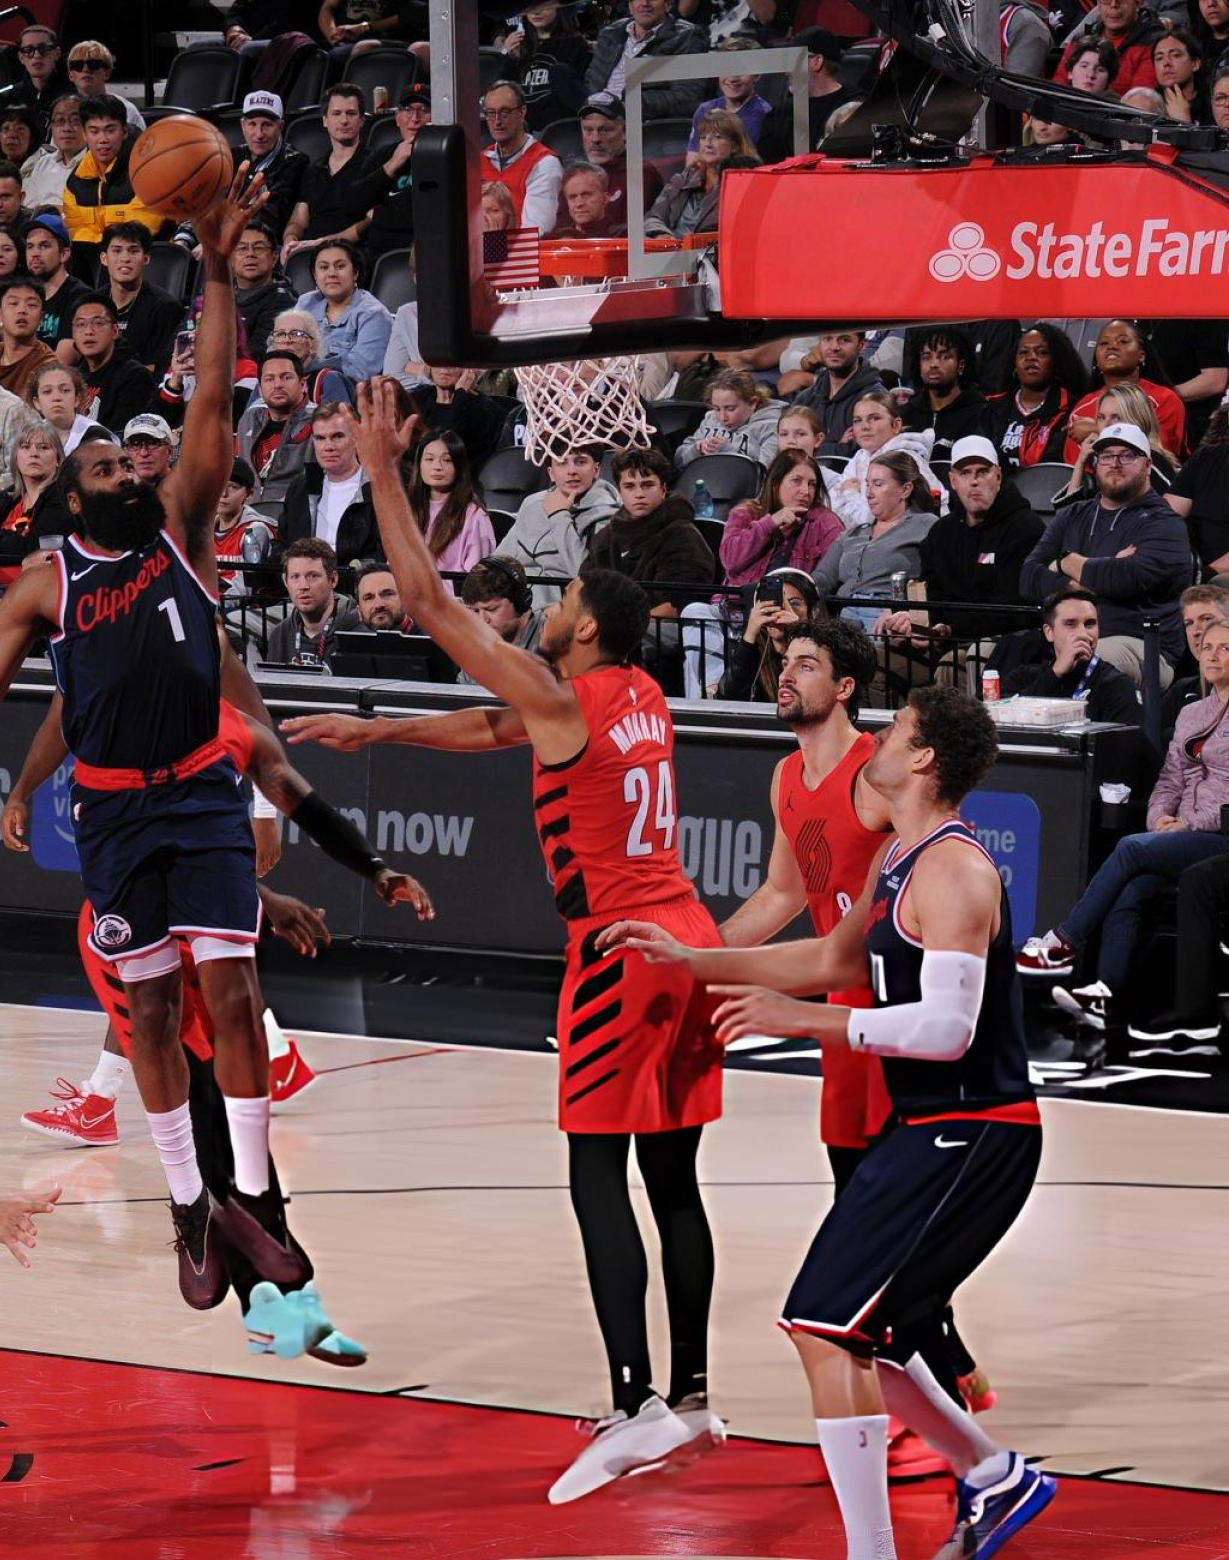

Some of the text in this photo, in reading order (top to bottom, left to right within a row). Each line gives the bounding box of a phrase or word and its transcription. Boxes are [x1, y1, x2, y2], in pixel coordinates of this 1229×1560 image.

[76, 549, 171, 633] Clippers
[157, 597, 186, 643] 1
[608, 711, 667, 755] MURRAY
[376, 809, 474, 857] now
[623, 760, 677, 858] 24
[677, 815, 762, 902] gue
